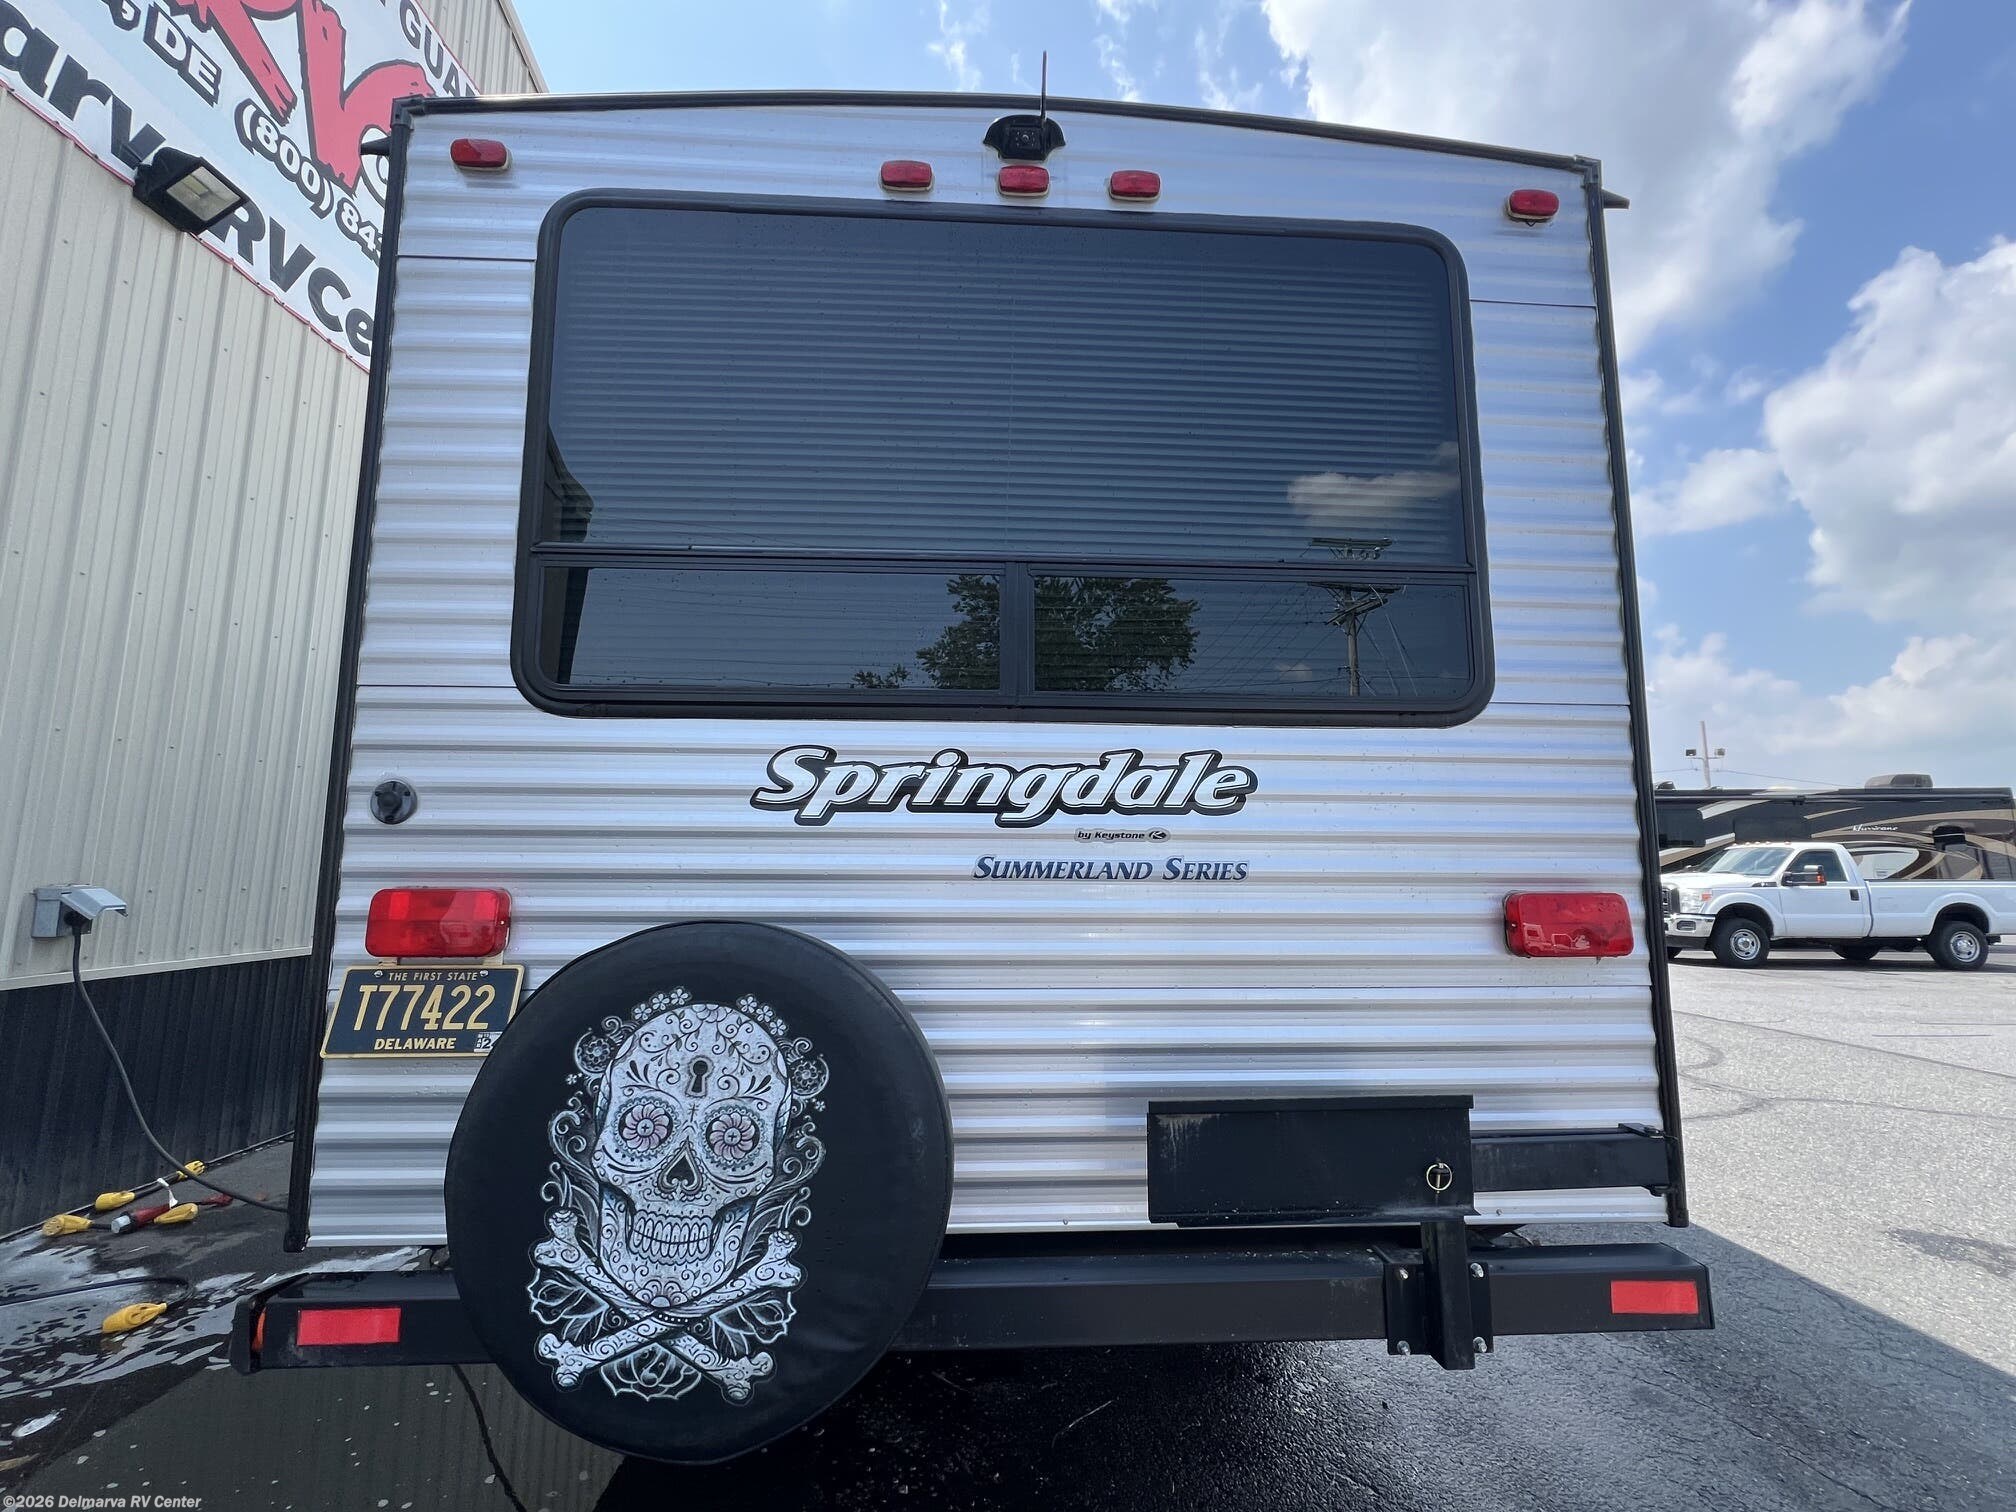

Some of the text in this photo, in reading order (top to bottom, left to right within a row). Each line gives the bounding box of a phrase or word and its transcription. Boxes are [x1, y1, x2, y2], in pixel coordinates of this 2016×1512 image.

[144, 3, 222, 107] DE
[400, 0, 476, 98] GUA
[235, 98, 334, 219] (800)
[750, 744, 1258, 828] Springdale
[1078, 831, 1145, 840] by Keystone
[972, 855, 1248, 881] SUMMERLAND SERIES
[388, 972, 478, 981] THE FIRST STATE
[354, 985, 496, 1030] T77422
[374, 1038, 457, 1050] DELAWARE
